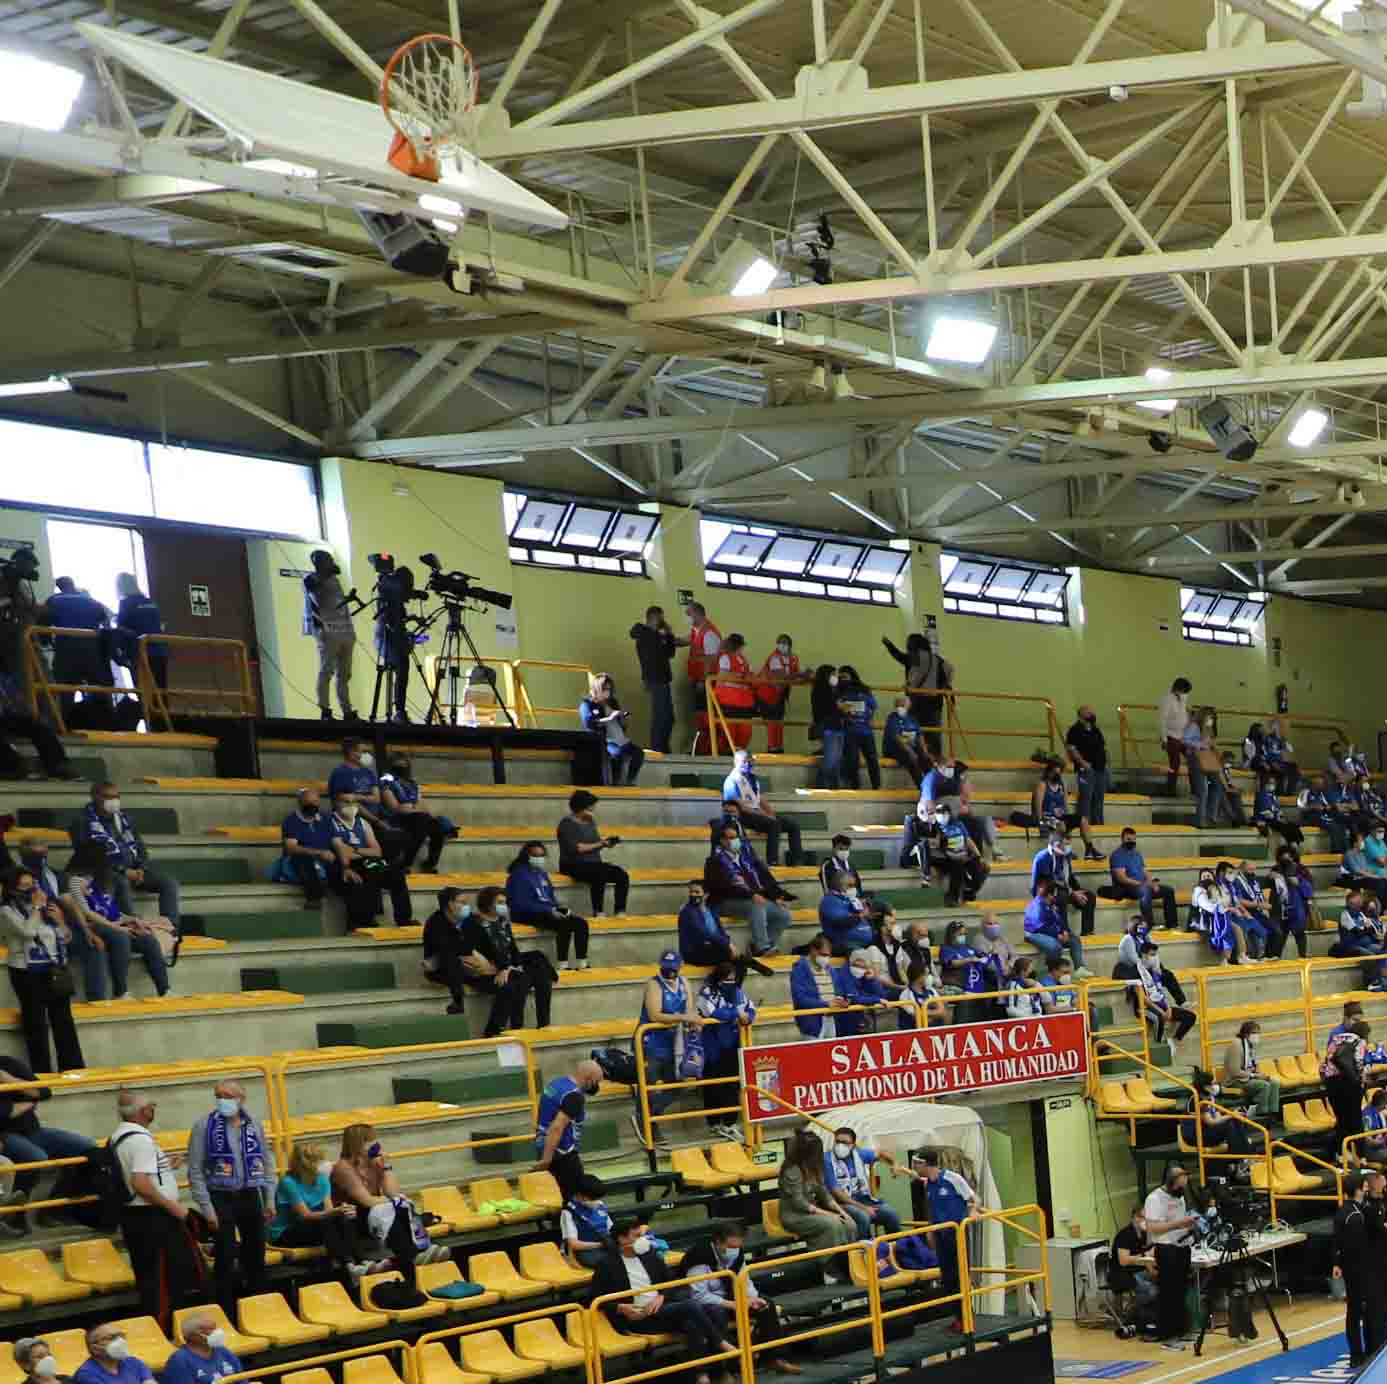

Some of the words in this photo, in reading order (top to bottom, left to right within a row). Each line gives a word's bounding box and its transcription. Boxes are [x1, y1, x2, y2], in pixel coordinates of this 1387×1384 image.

[831, 1023, 1052, 1075] SALAMANCA
[792, 1069, 917, 1108] PATRIMONIO
[923, 1065, 948, 1091] DE
[953, 1063, 976, 1087] LA
[979, 1049, 1079, 1082] HUMANIDAD
